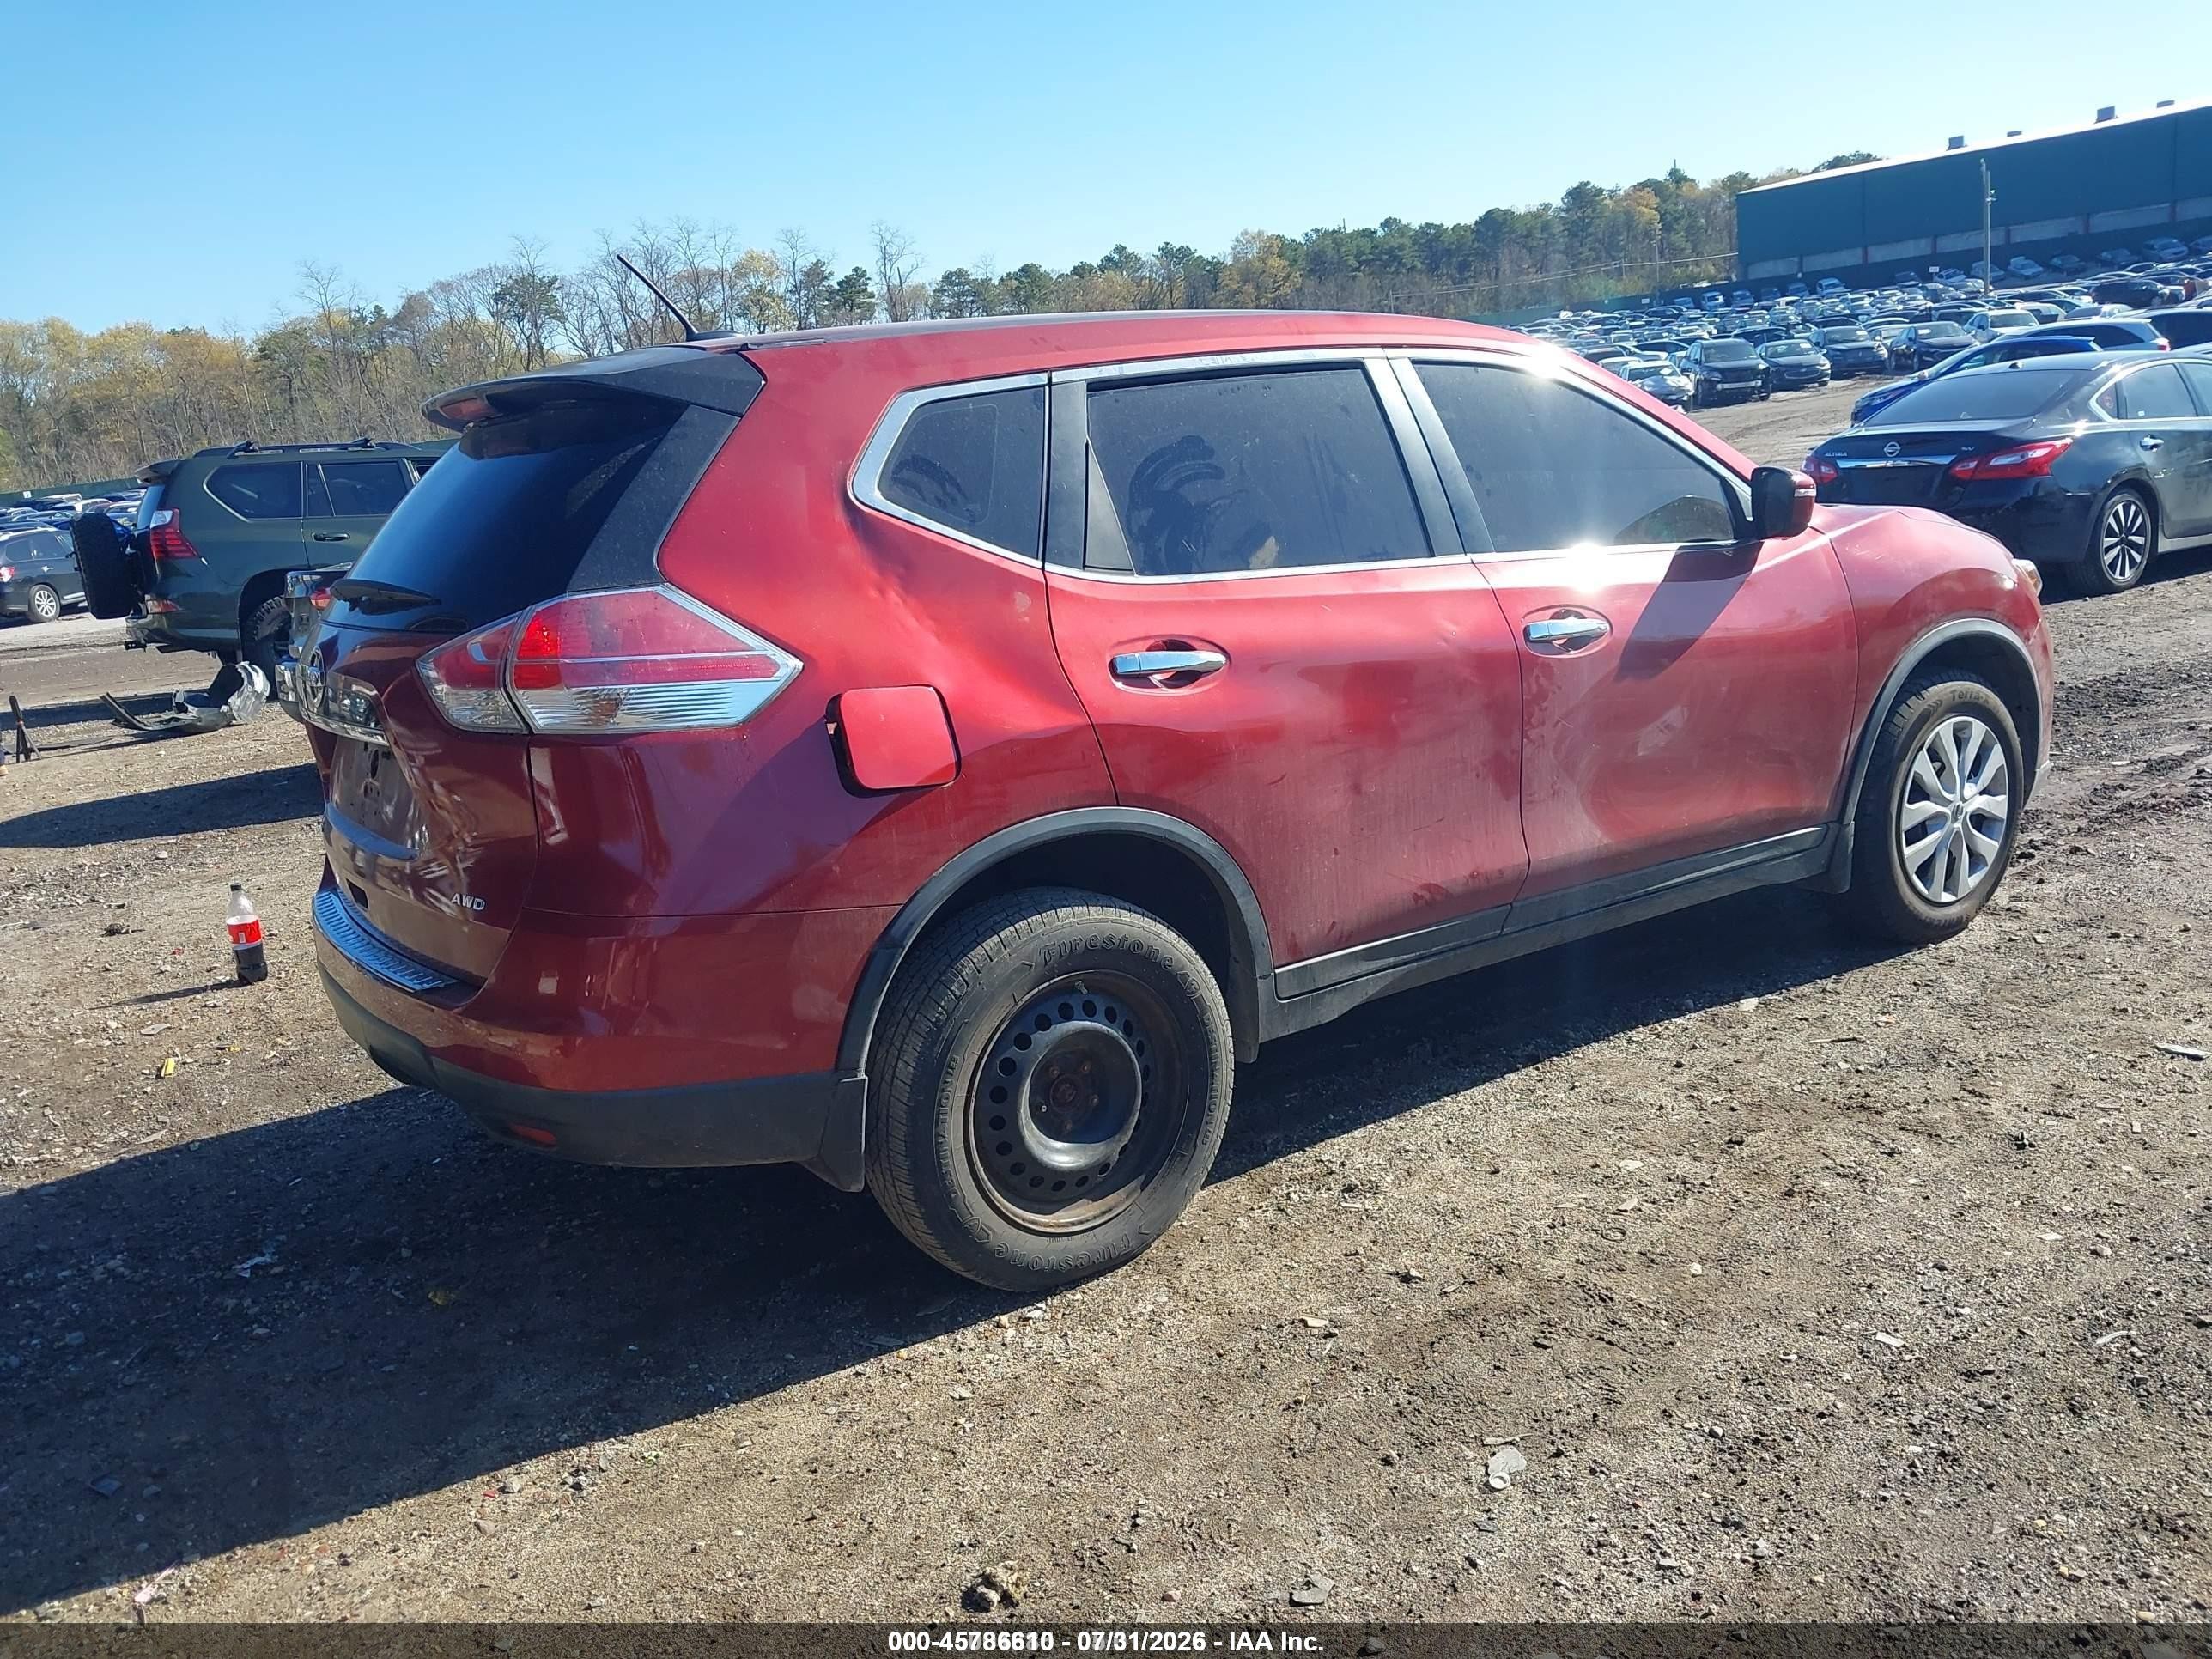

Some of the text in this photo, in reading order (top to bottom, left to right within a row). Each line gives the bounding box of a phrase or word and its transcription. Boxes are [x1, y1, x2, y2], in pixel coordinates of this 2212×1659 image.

[451, 893, 485, 910] AWD
[1039, 933, 1175, 970] Firestone
[994, 1233, 1134, 1272] Firestone
